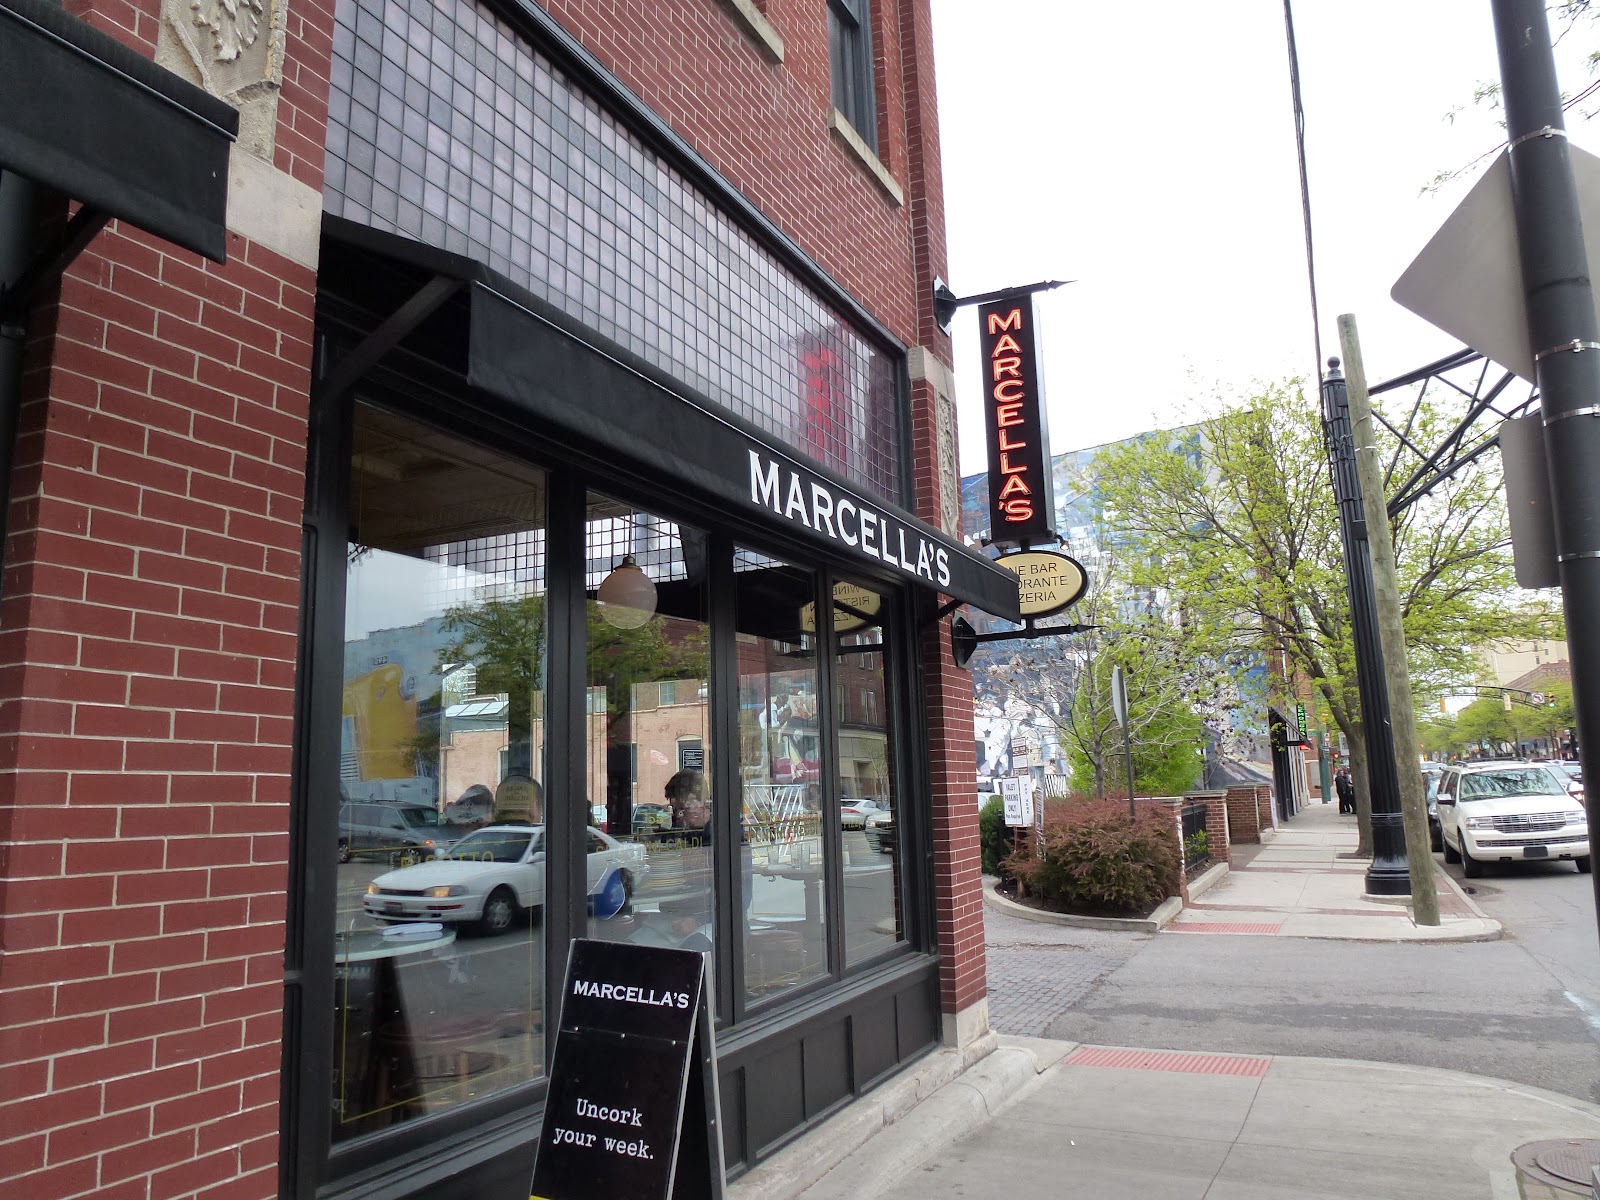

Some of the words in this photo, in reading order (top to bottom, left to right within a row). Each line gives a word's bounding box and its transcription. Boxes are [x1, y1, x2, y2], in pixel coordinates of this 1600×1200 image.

[988, 308, 1034, 523] MARCELLA'S
[748, 449, 951, 588] MARCELLA'S
[1007, 565, 1026, 576] NE
[1030, 562, 1058, 575] BAR
[1019, 590, 1057, 603] ZERIA
[573, 980, 690, 1009] MARCELLA'S
[576, 1098, 642, 1127] Uncork
[553, 1127, 597, 1147] your
[604, 1137, 654, 1160] week.
